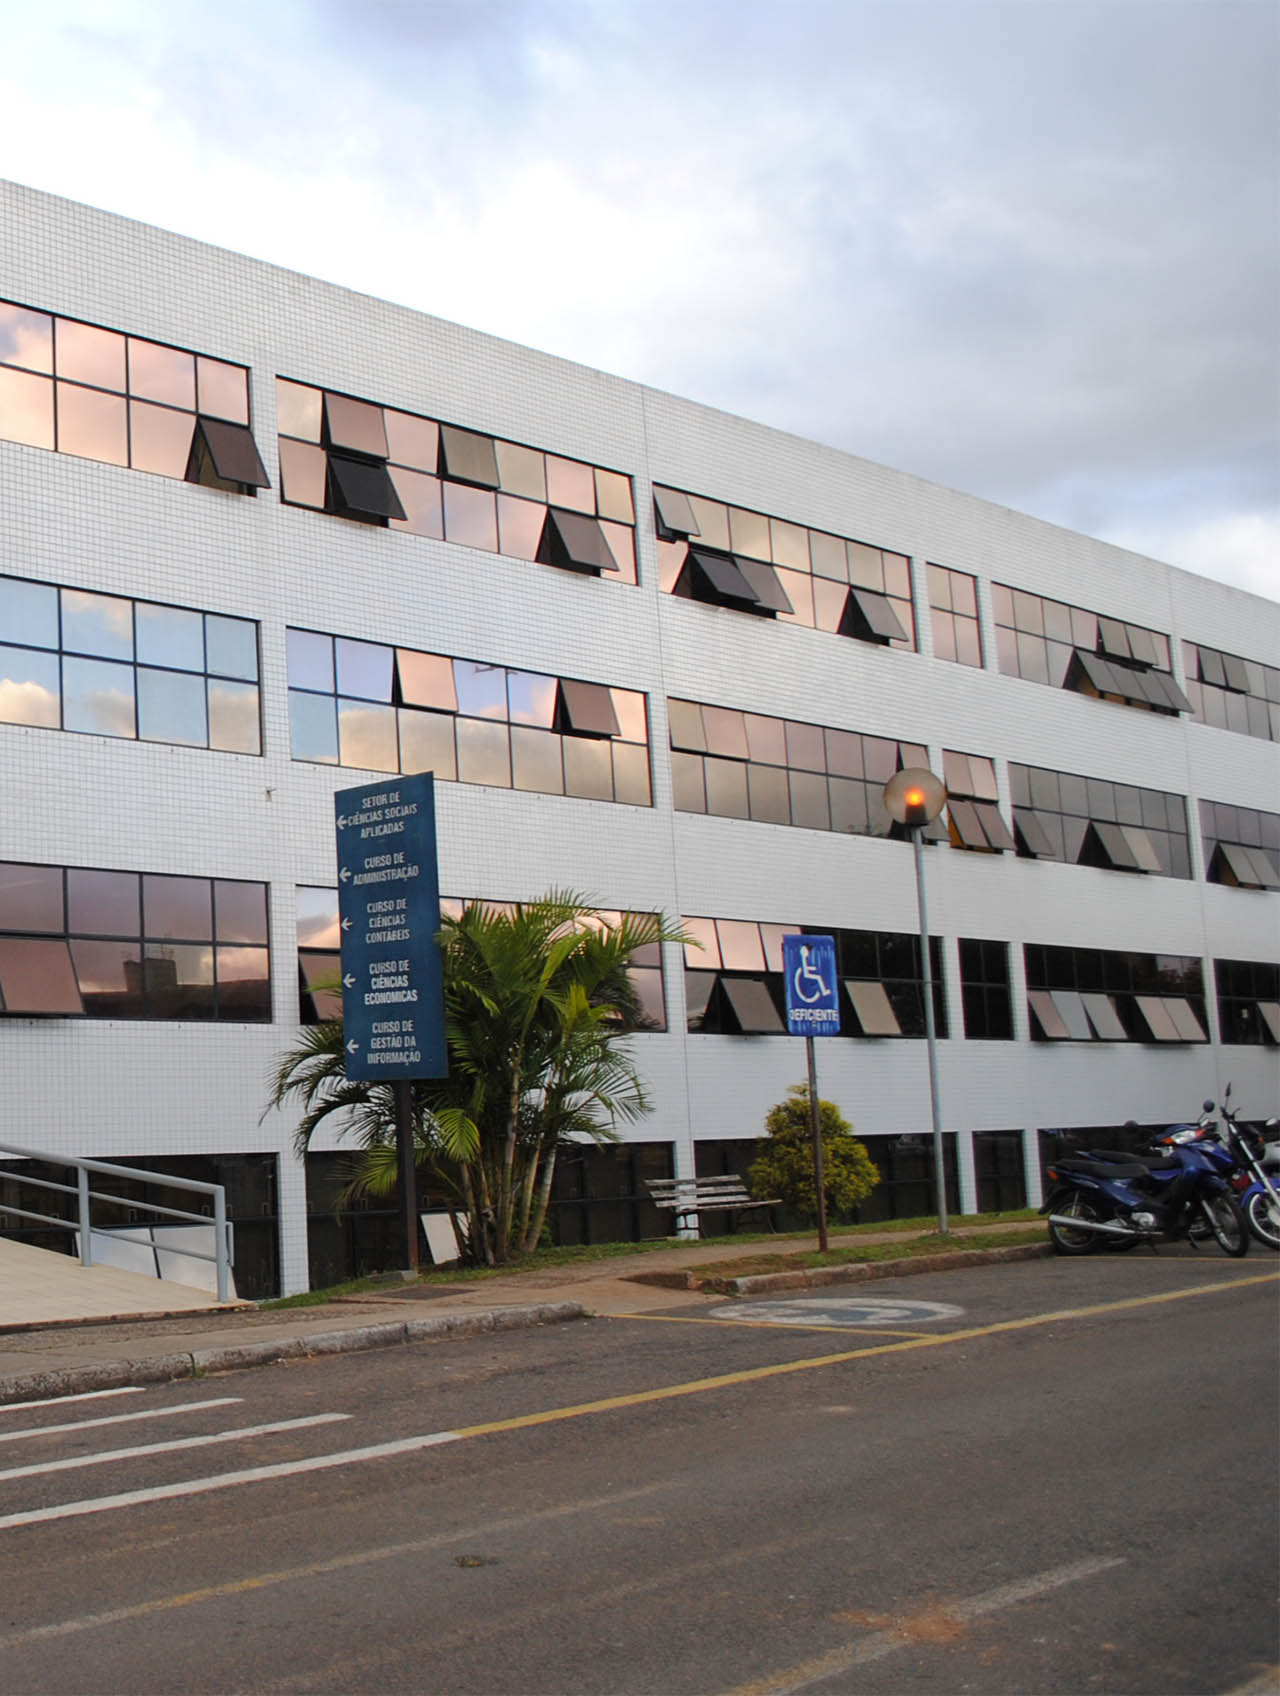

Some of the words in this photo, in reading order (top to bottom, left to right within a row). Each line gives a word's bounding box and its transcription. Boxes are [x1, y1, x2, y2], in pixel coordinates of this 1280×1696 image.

[361, 794, 388, 808] SETOR
[389, 791, 400, 803] DE
[347, 810, 383, 826] CIÊNCIAS
[384, 803, 418, 819] SOCIAIS
[361, 821, 405, 838] APLICADAS
[364, 855, 391, 869] CURSO
[393, 852, 405, 864] DE
[353, 863, 419, 885] ADMINISTRAÇÃO
[367, 900, 394, 913] CURSO
[396, 898, 408, 910] DE
[369, 913, 406, 928] CIÊNCIAS
[365, 927, 410, 944] CONTÁBEIS
[369, 961, 396, 974] CURSO
[399, 960, 410, 972] DE
[371, 974, 408, 990] CIÊNCIAS
[790, 1008, 839, 1021] DEFICIENTE
[372, 1020, 400, 1034] CURSO
[401, 1019, 414, 1032] DE
[370, 1033, 402, 1048] GESTÃO
[404, 1035, 417, 1048] DA
[367, 1048, 421, 1066] INFORMAÇÃO
